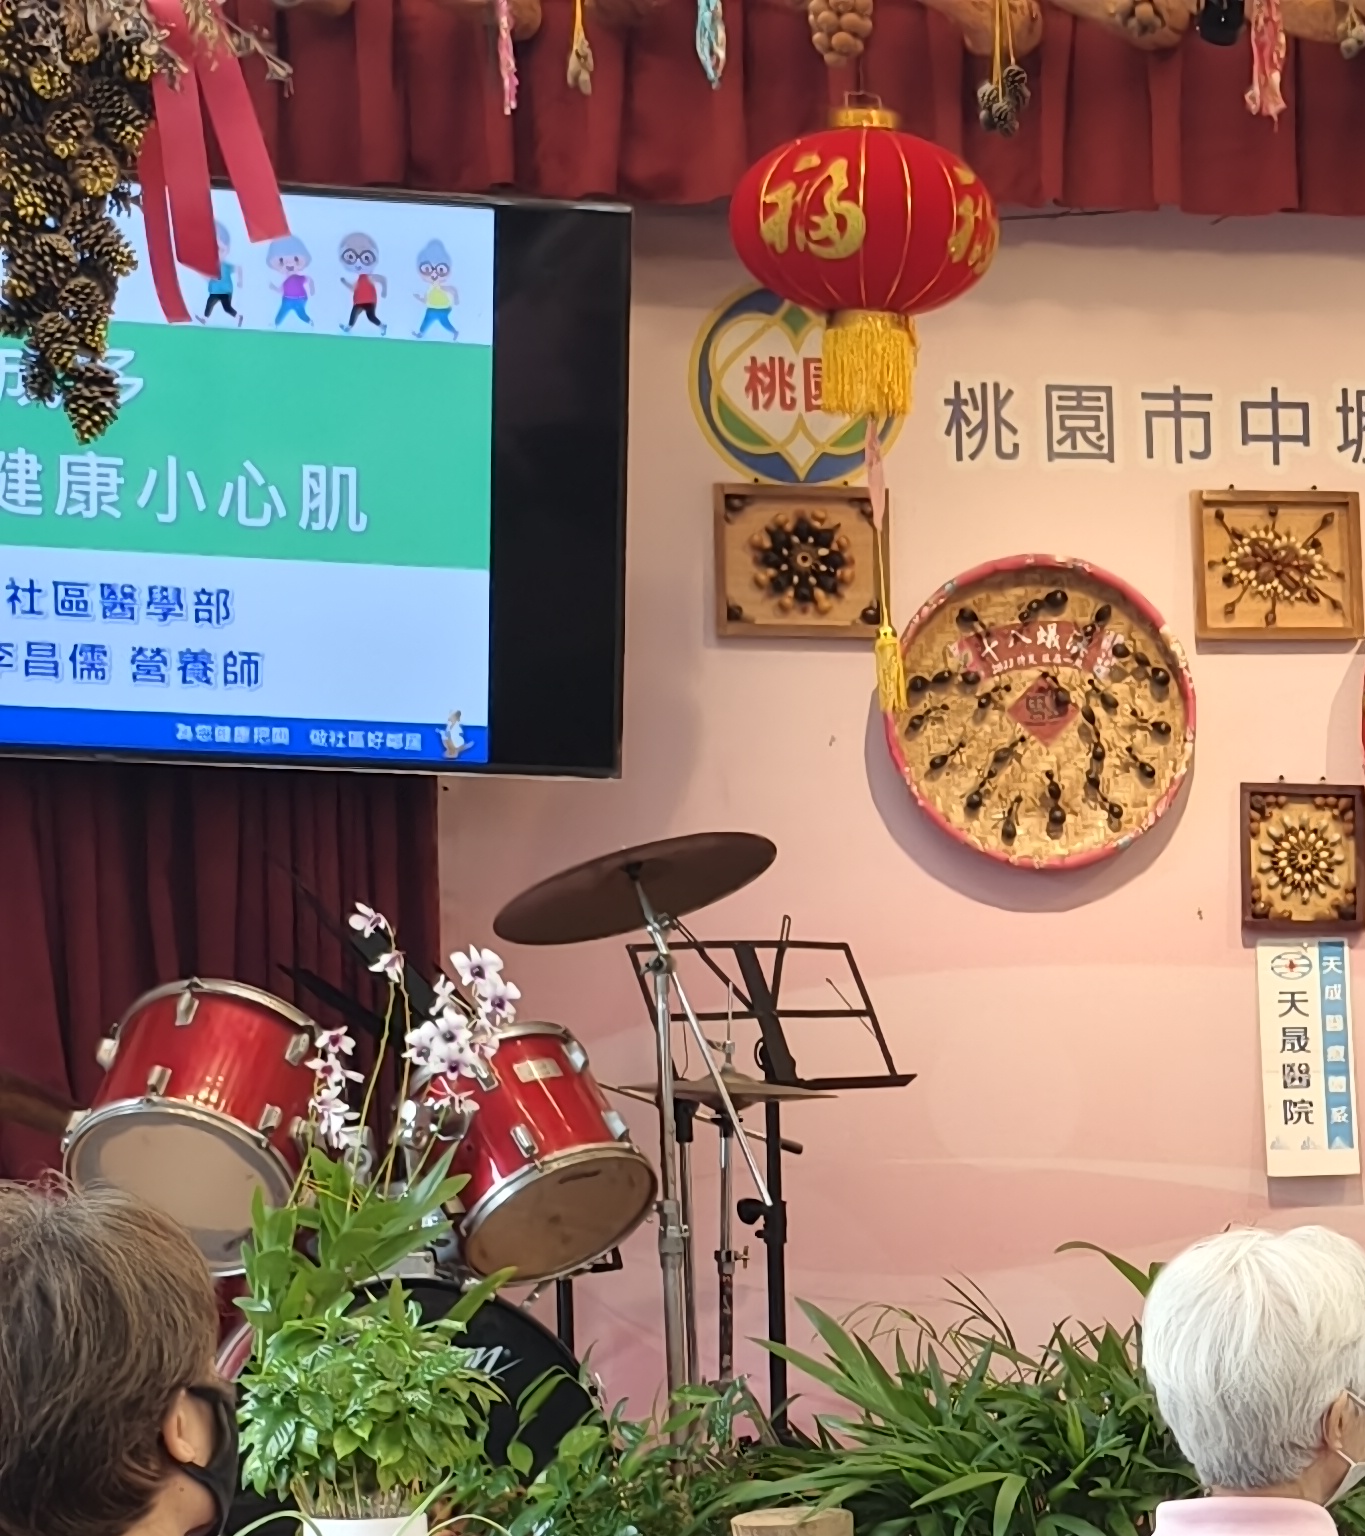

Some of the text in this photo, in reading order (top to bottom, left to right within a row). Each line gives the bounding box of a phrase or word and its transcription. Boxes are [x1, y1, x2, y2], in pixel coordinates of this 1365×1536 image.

[761, 154, 866, 260] 福
[0, 447, 368, 532] 健康小心肌
[5, 577, 232, 625] 社區醫學部
[130, 646, 262, 688] 營養師
[1277, 990, 1315, 1126] 天晟醫院
